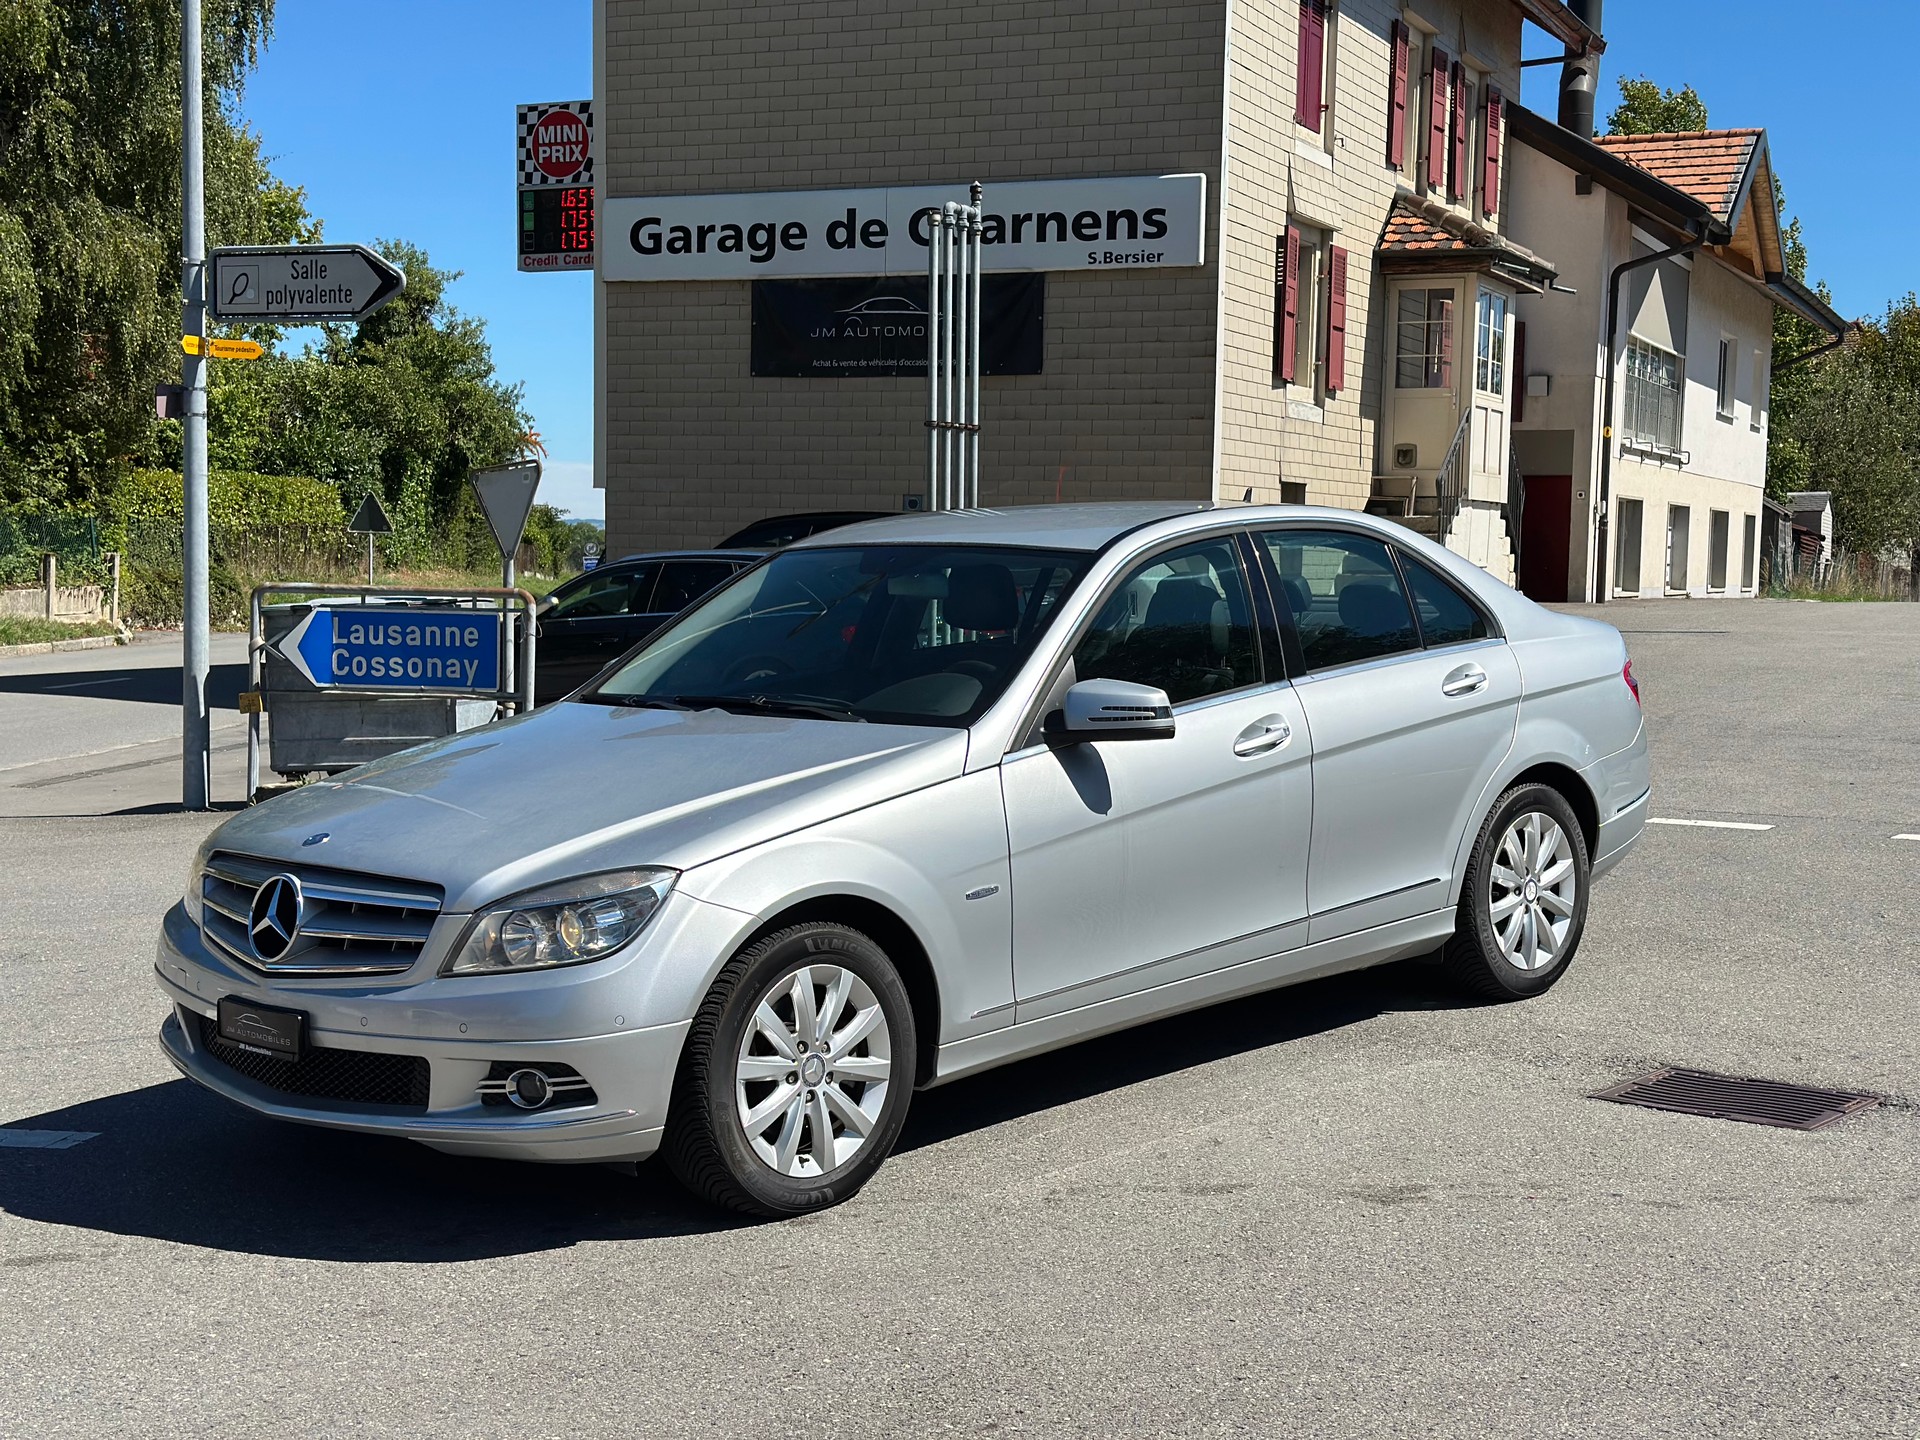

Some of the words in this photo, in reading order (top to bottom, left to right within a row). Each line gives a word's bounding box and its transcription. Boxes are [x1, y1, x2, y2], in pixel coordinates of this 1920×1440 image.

[538, 124, 583, 144] MINI
[538, 144, 584, 164] PRIX
[629, 217, 808, 263] Garage
[825, 208, 889, 250] de
[523, 255, 559, 267] Credit
[1087, 249, 1165, 266] S.Bersier
[290, 260, 328, 280] Salle
[266, 284, 353, 310] polyvalente
[811, 327, 836, 338] JM
[844, 325, 944, 338] AUTOMO
[812, 360, 831, 368] Achat
[832, 360, 838, 368] &
[859, 359, 868, 368] de
[868, 358, 897, 368] véhicules
[899, 357, 929, 368] d'occasio
[332, 617, 480, 648] Lausanne
[332, 649, 480, 686] Cossonay
[237, 1028, 291, 1046] AUTOMOBILES
